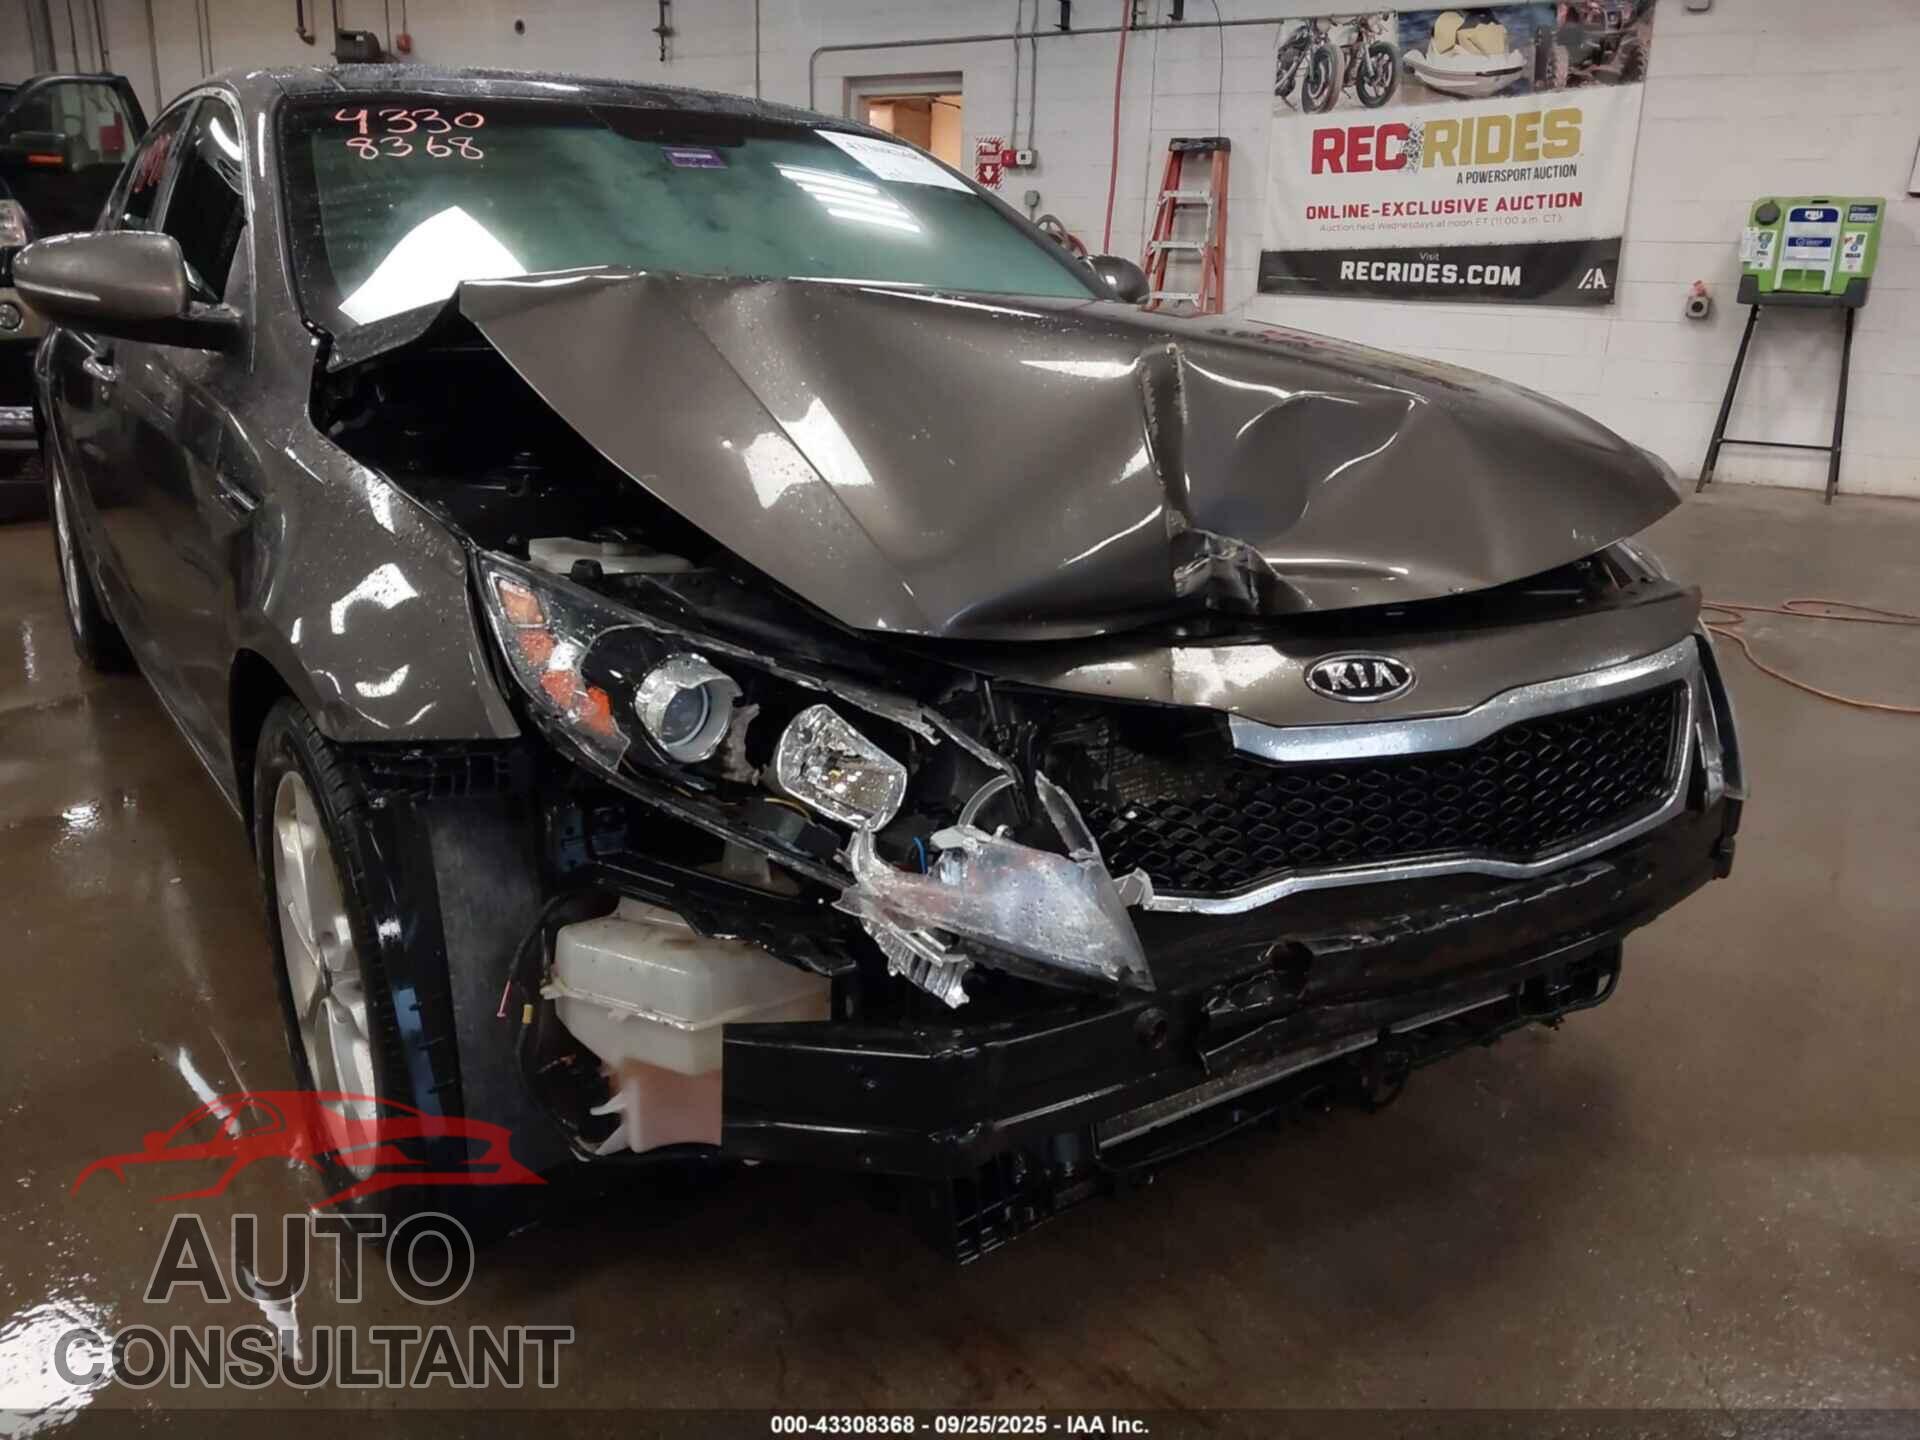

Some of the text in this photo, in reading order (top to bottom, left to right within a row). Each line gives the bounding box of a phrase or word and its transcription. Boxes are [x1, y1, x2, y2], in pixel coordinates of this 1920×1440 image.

[335, 108, 485, 134] 4330
[345, 136, 485, 160] 8368
[1310, 107, 1584, 175] REC RIDES
[1456, 163, 1577, 185] A POWERSPORT AUCTION
[1306, 191, 1583, 220] ONLINE-EXCLUSIVE AUCTION
[1419, 251, 1440, 261] Visit
[1340, 260, 1521, 287] RECRIDES.COM
[1315, 661, 1400, 690] KIA
